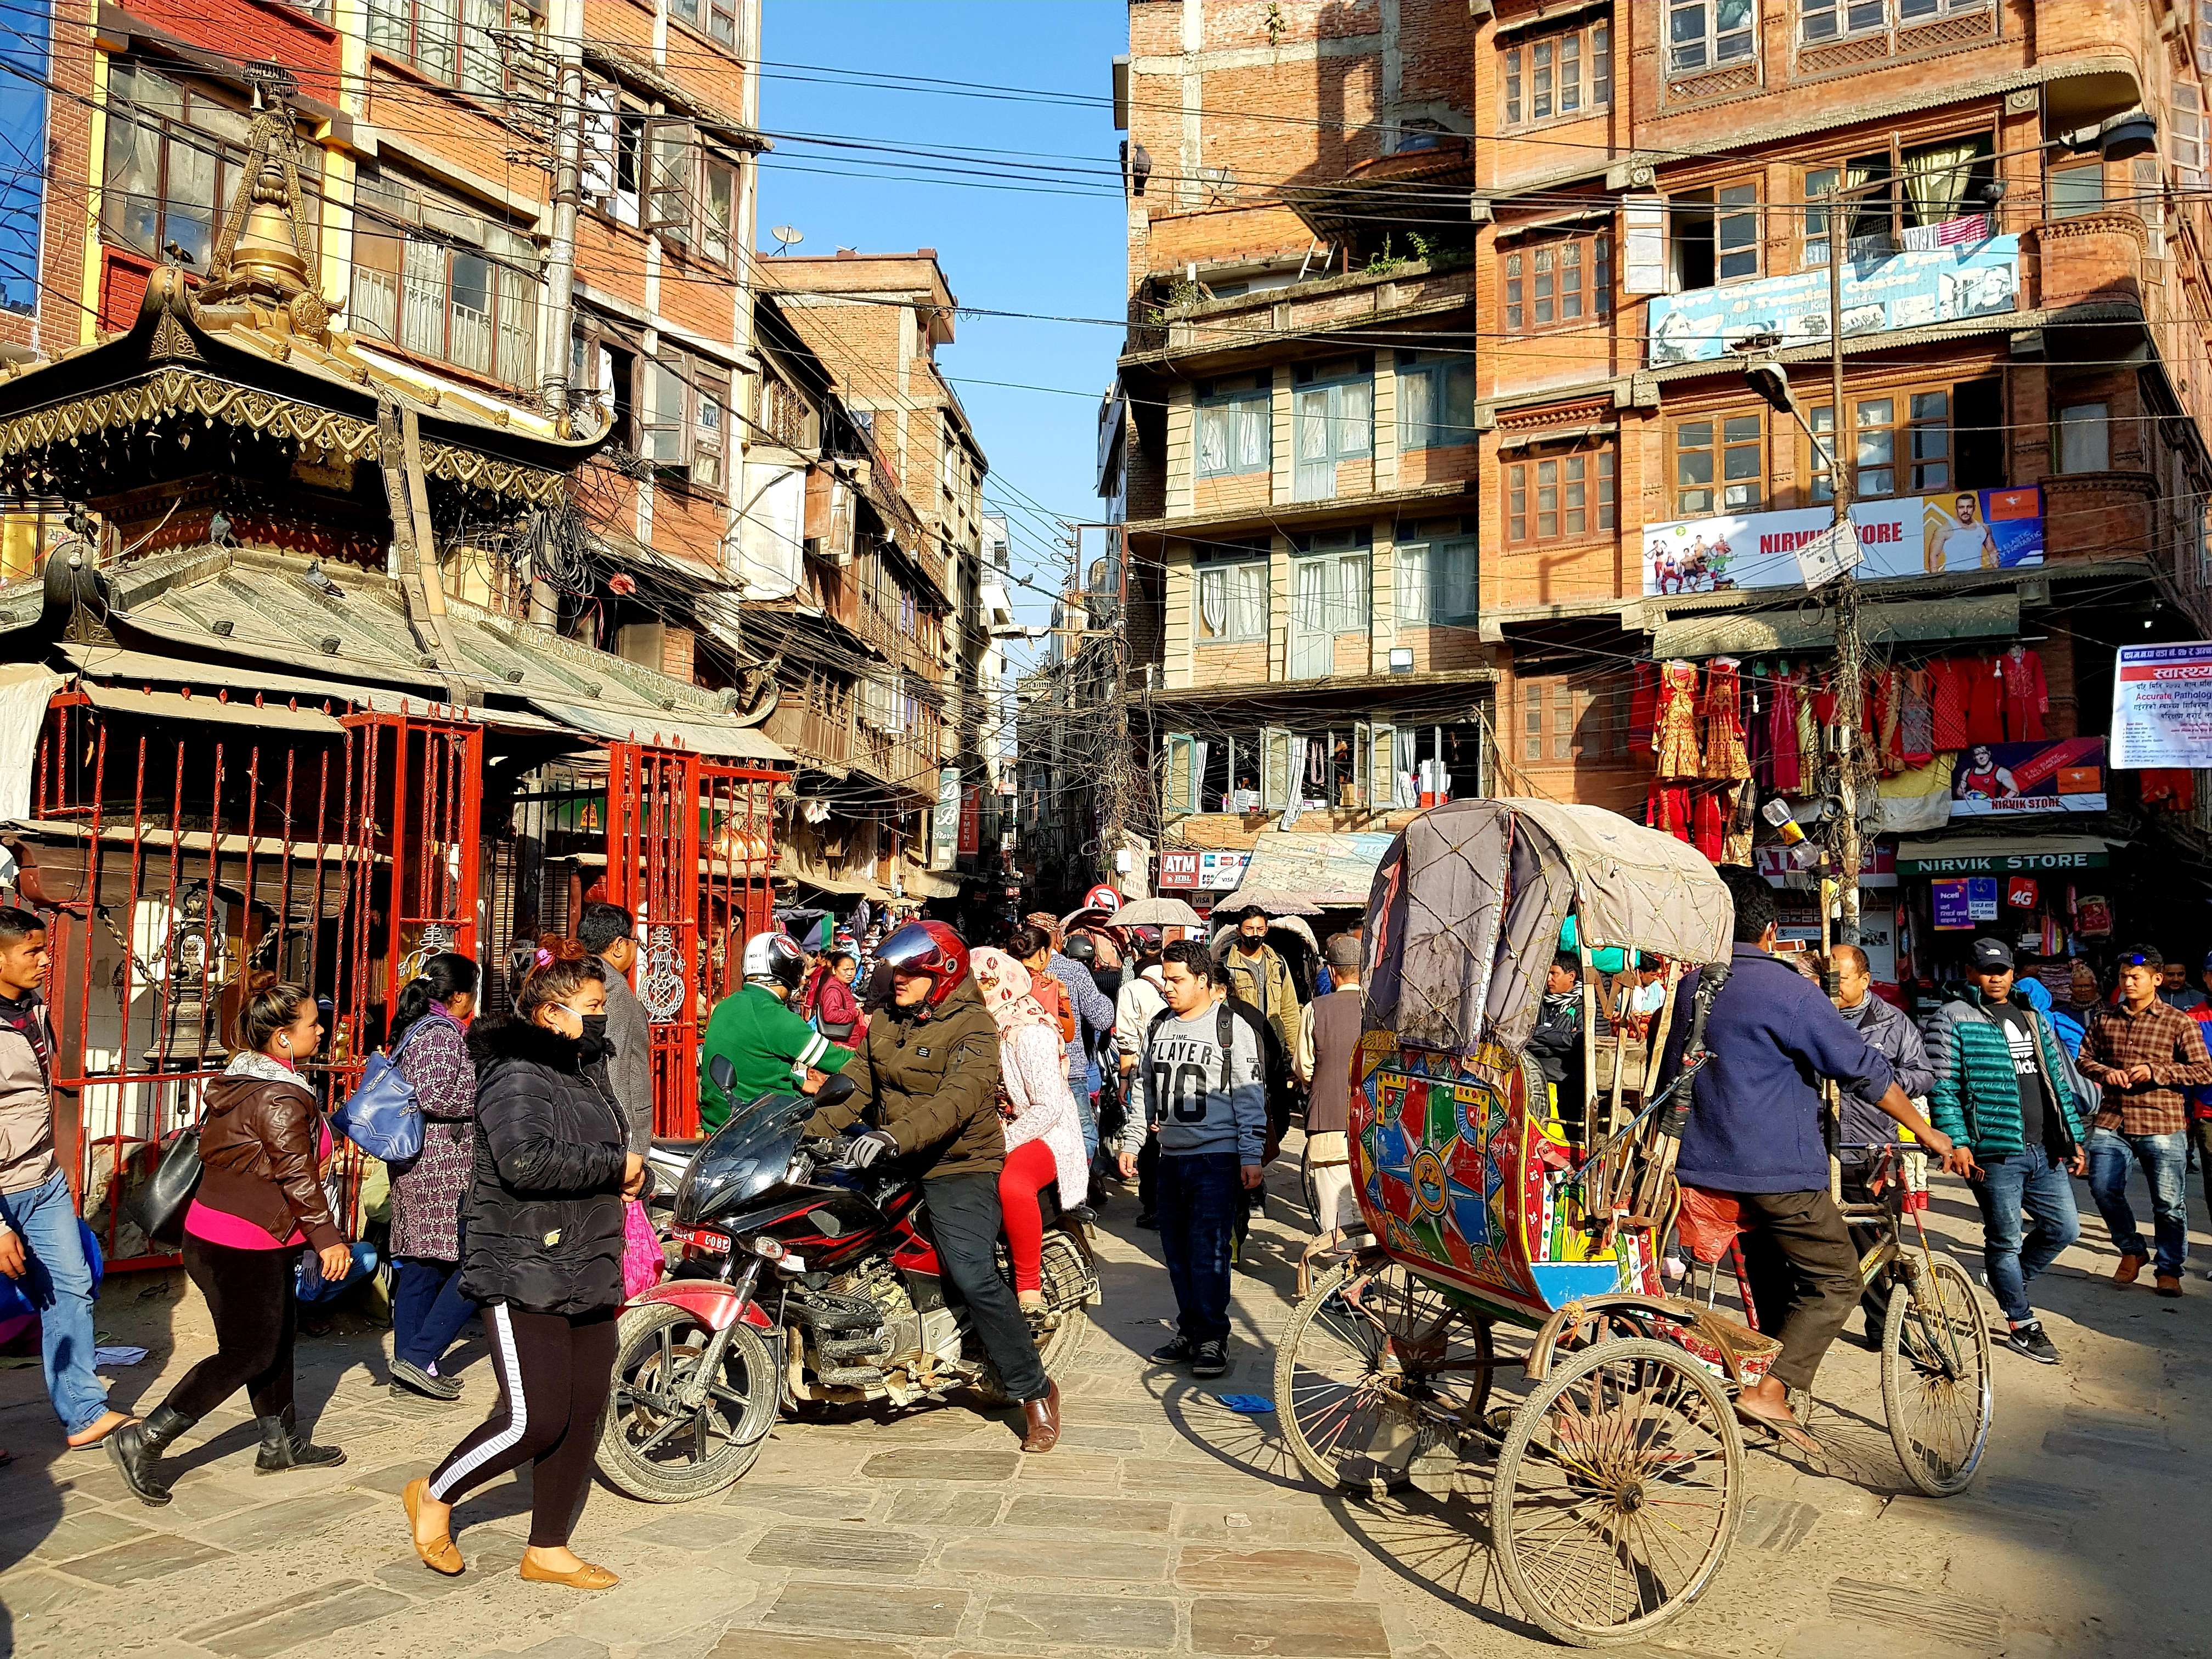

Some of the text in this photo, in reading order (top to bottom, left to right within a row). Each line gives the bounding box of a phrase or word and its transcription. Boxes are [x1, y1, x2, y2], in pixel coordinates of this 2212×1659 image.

[2136, 692, 2172, 701] Accurate
[1164, 855, 1196, 873] ATM
[1918, 854, 2088, 872] NIRVIK STORE
[1125, 878, 1143, 892] ATM
[1175, 874, 1192, 883] HBL
[2011, 890, 2033, 905] 4G
